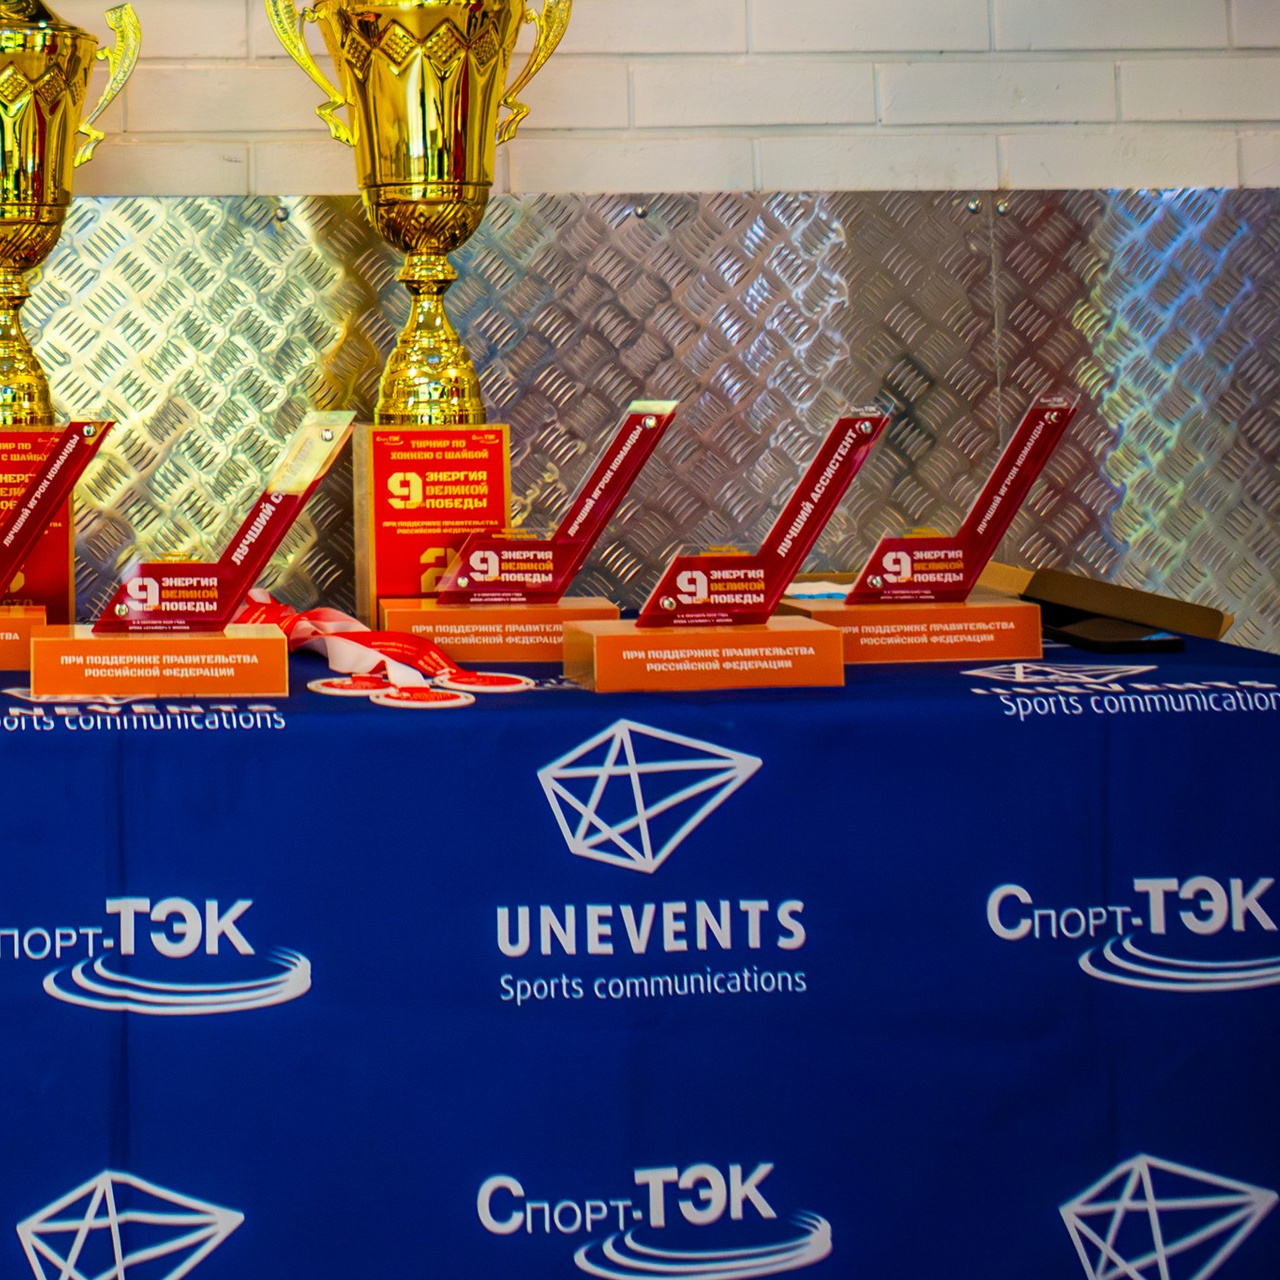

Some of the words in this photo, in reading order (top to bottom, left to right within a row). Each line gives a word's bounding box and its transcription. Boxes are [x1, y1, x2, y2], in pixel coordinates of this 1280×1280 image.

[10, 451, 48, 462] ШАЙБО
[425, 470, 488, 483] ЭНЕРГИЯ
[567, 497, 596, 538] ЛУЧШИЙ
[591, 469, 615, 500] ИГРОК
[609, 424, 643, 472] КОМАНДЫ
[976, 494, 1003, 536] ЛУЧШИЙ
[998, 465, 1020, 497] ИГРОК
[1015, 420, 1046, 468] КОМАНДЫ
[2, 507, 32, 548] ЛУЧШИЙ
[28, 477, 51, 511] ИГРОК
[46, 433, 81, 481] КОМАНДЫ
[387, 472, 423, 510] 9
[425, 482, 489, 496] ВЕЛИКОЙ
[776, 500, 815, 558] ЛУЧШИЙ
[810, 428, 857, 504] АССИСТЕНТ
[425, 497, 488, 510] ПОБЕДЫ
[231, 501, 277, 566] ЛУЧШИЙ
[500, 550, 554, 560] ЭНЕРГИЯ
[912, 549, 964, 561] ЭНЕРГИЯ
[469, 550, 500, 583] 9
[500, 559, 554, 571] ВЕЛИКОЙ
[881, 550, 913, 584] 9
[500, 572, 553, 583] ПОБЕДЫ
[709, 569, 765, 580] ЭНЕРГИЯ
[912, 572, 964, 583] ПОБЕДЫ
[161, 576, 218, 588] ЭНЕРГИЯ
[676, 570, 709, 605] 9
[709, 579, 766, 592] ВЕЛИКОЙ
[126, 576, 160, 612] 9
[161, 587, 219, 599] ВЕЛИКОЙ
[709, 593, 765, 605] ПОБЕДЫ
[161, 600, 218, 613] ПОБЕДЫ
[411, 624, 435, 634] ПРИ
[435, 624, 503, 634] ПОДДЕРЖКЕ
[861, 623, 928, 634] ПОДДЕРЖКЕ
[929, 620, 1016, 632] ПРАВИТЕЛЬСТВА
[433, 633, 503, 645] РОССИЙСКОЙ
[505, 634, 563, 645] ФЕДЕРАЦИ
[860, 633, 929, 646] РОССИЙСКОЙ
[930, 633, 995, 644] ФЕДЕРАЦИИ
[622, 649, 646, 660] ПРИ
[647, 648, 721, 660] ПОДДЕРЖКЕ
[721, 646, 816, 658] ПРАВИТЕЛЬСТВА
[60, 655, 85, 665] ПРИ
[85, 655, 161, 666] ПОДДЕРЖКЕ
[162, 654, 259, 665] ПРАВИТЕЛЬСТВА
[646, 659, 721, 672] РОССИЙСКОЙ
[721, 659, 793, 670] ФЕДЕРАЦИИ
[84, 665, 161, 678] РОССИЙСКОЙ
[162, 667, 236, 678] ФЕДЕРАЦИИ
[999, 693, 1084, 722] Sports
[1089, 688, 1280, 715] communication
[496, 899, 807, 958] UNEVENTS
[499, 972, 585, 1007] Sports
[592, 965, 808, 1000] communications
